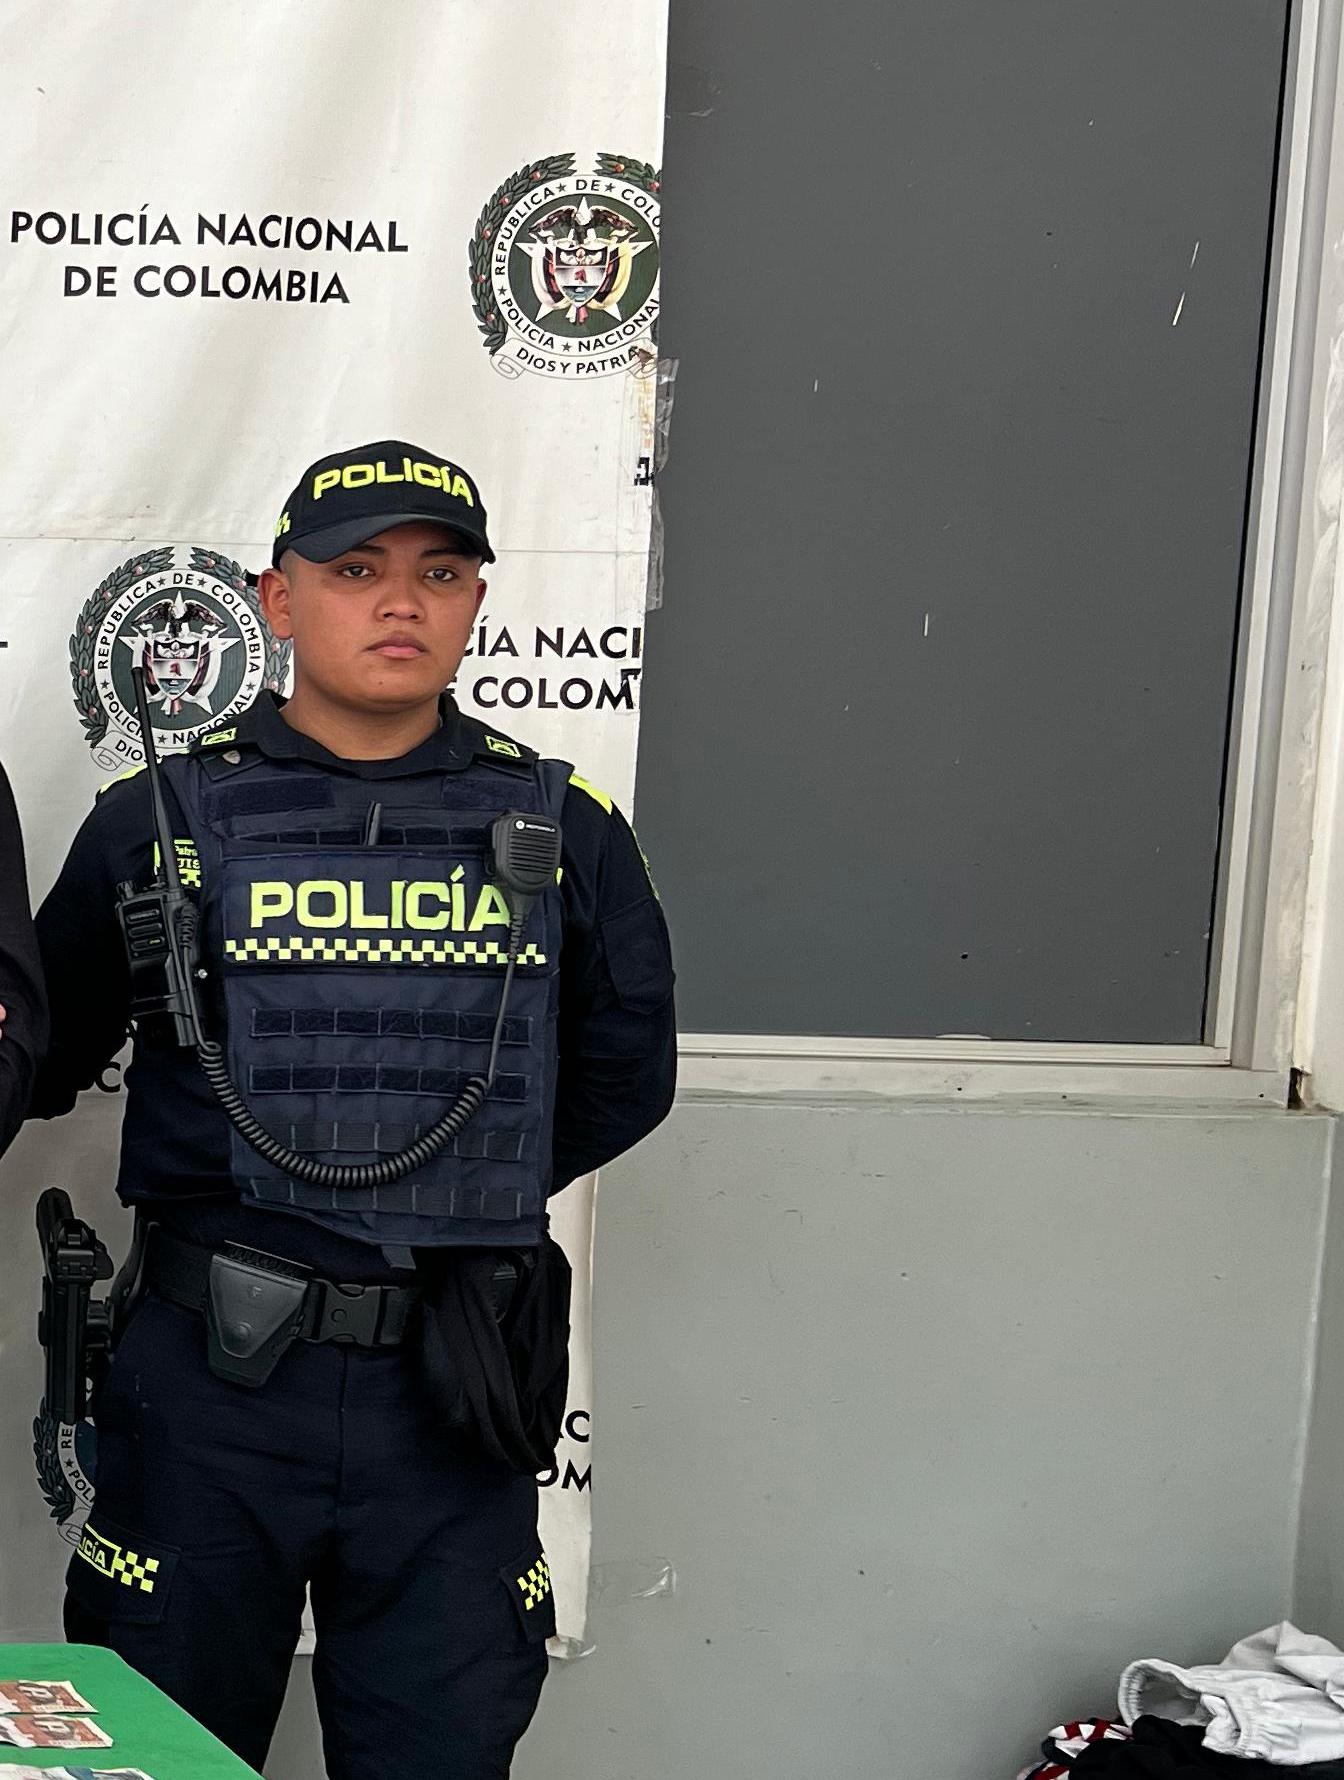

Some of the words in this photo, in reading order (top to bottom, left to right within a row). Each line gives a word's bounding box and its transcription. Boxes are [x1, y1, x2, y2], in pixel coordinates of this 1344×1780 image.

[10, 203, 181, 246] POLICÍA
[197, 213, 409, 253] NACIONAL
[63, 265, 117, 297] DE
[133, 264, 350, 304] COLOMBIA
[313, 457, 475, 508] POLICÍA
[534, 626, 642, 659] NACI
[472, 676, 634, 711] COLOM
[250, 864, 514, 933] POLICÍA
